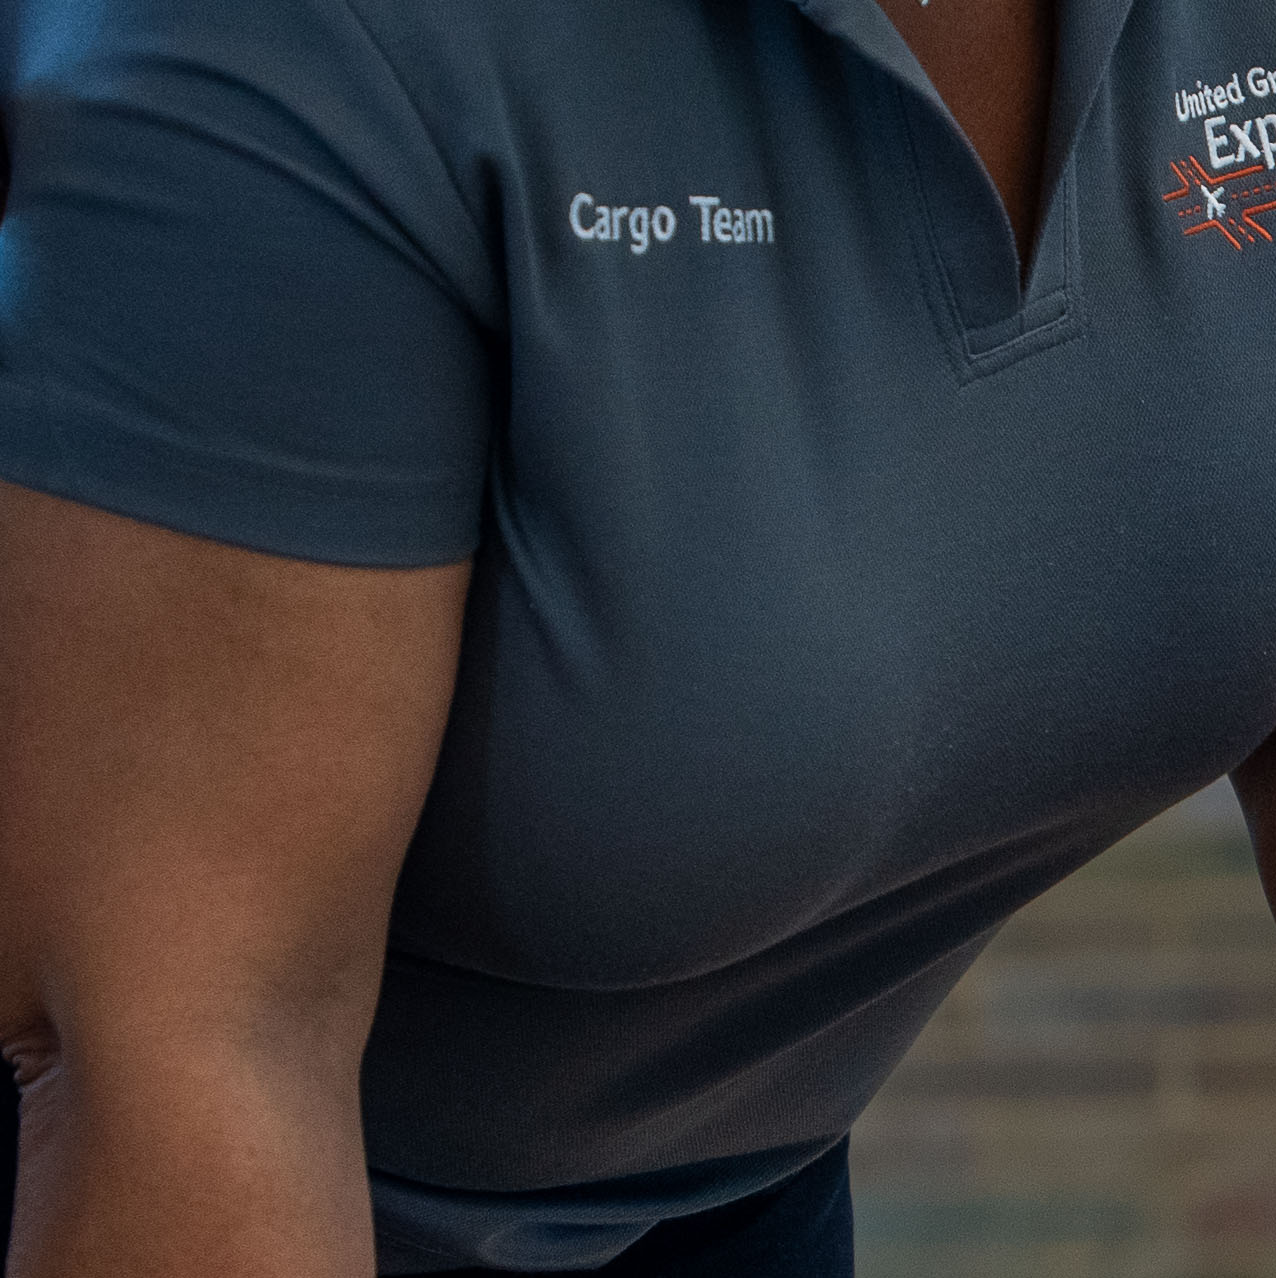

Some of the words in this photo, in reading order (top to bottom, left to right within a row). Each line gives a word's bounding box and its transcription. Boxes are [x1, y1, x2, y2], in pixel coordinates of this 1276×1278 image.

[1175, 73, 1246, 122] United
[569, 192, 676, 254] Cargo
[689, 195, 775, 243] Team
